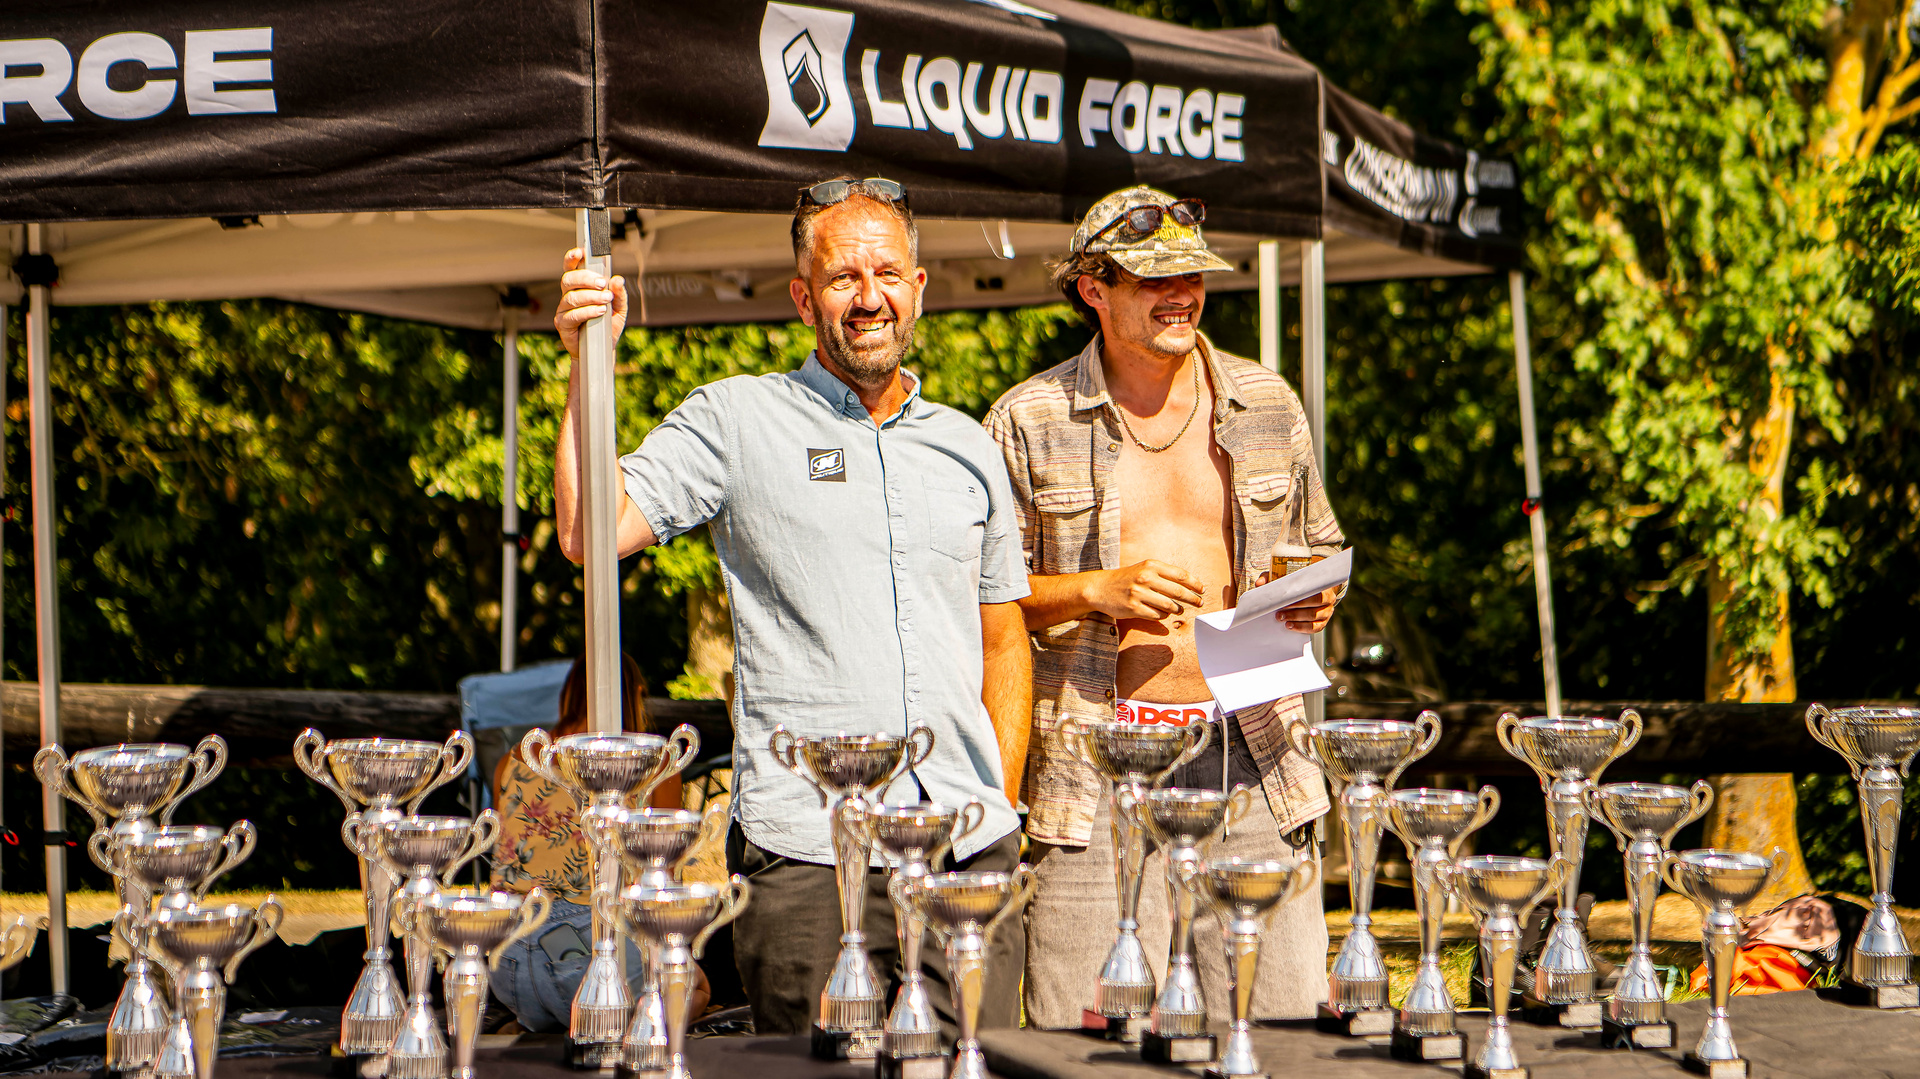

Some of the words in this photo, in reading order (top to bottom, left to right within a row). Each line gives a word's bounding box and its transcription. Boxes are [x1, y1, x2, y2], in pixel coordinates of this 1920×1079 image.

[0, 27, 277, 124] RCE
[861, 48, 1064, 151] LIQUID
[1078, 76, 1246, 163] FORCE
